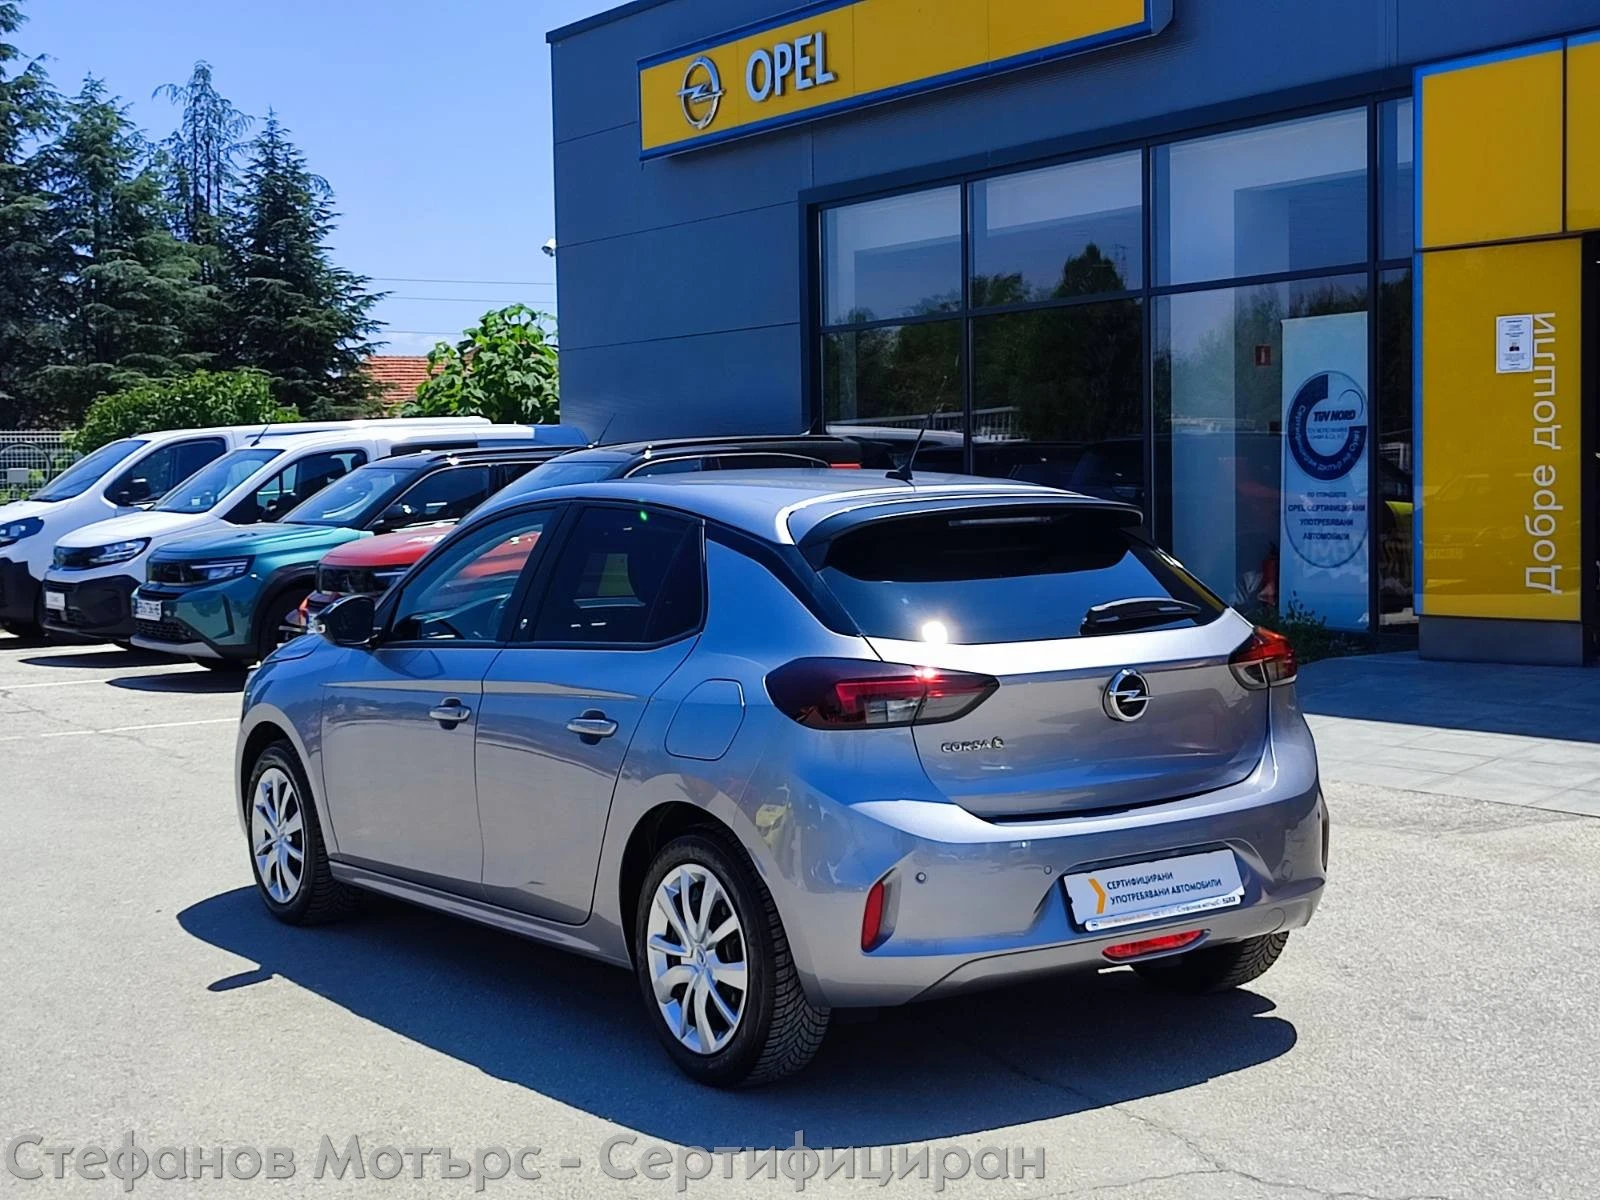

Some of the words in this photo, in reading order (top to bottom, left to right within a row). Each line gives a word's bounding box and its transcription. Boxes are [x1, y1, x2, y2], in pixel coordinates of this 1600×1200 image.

[745, 31, 836, 102] OPEL
[1532, 311, 1562, 450] дошли
[1524, 463, 1564, 595] Добре
[941, 740, 992, 753] CORSA
[1106, 871, 1174, 891] СЕРТИФИЦИРАНИ
[1110, 888, 1170, 905] УПОТРЕБЯВАНИ
[1171, 878, 1222, 895] АВТОМОБИЛИ
